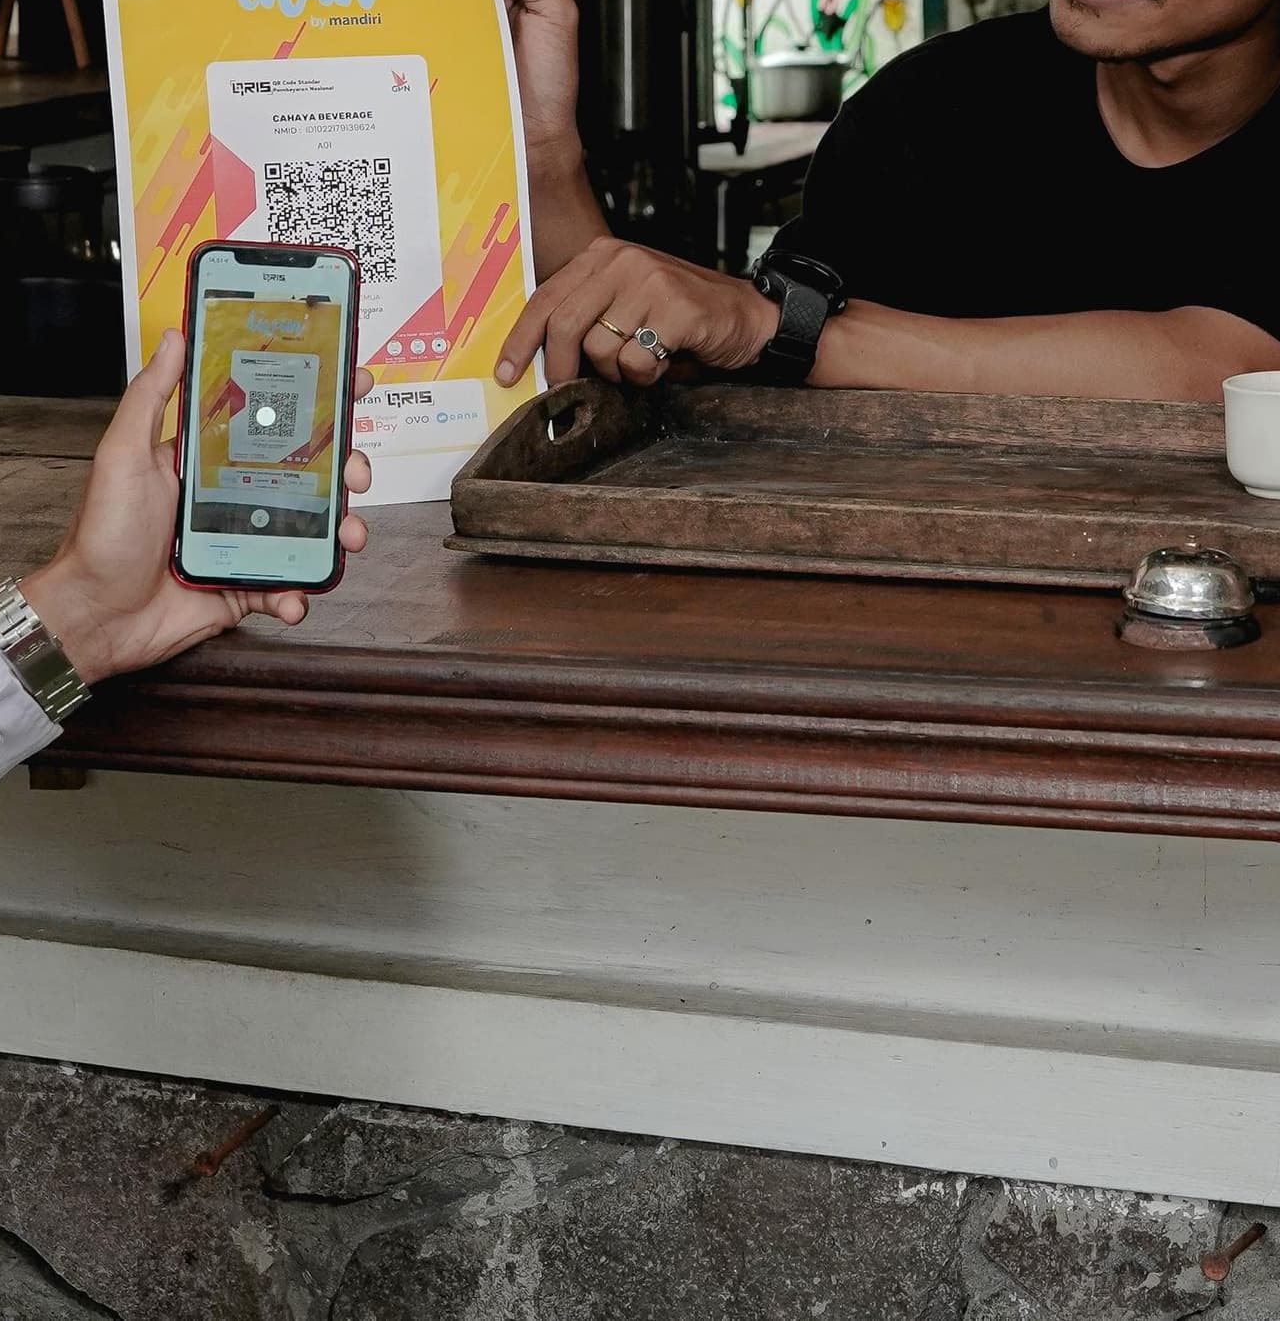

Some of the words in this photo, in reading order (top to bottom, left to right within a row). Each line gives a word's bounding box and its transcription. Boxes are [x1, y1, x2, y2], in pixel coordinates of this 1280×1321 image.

[309, 14, 326, 28] by
[329, 13, 382, 26] mandiri
[272, 112, 317, 123] CAHAYA
[318, 110, 373, 121] BEVERAGE
[274, 126, 298, 135] NMID
[375, 421, 398, 433] Pay
